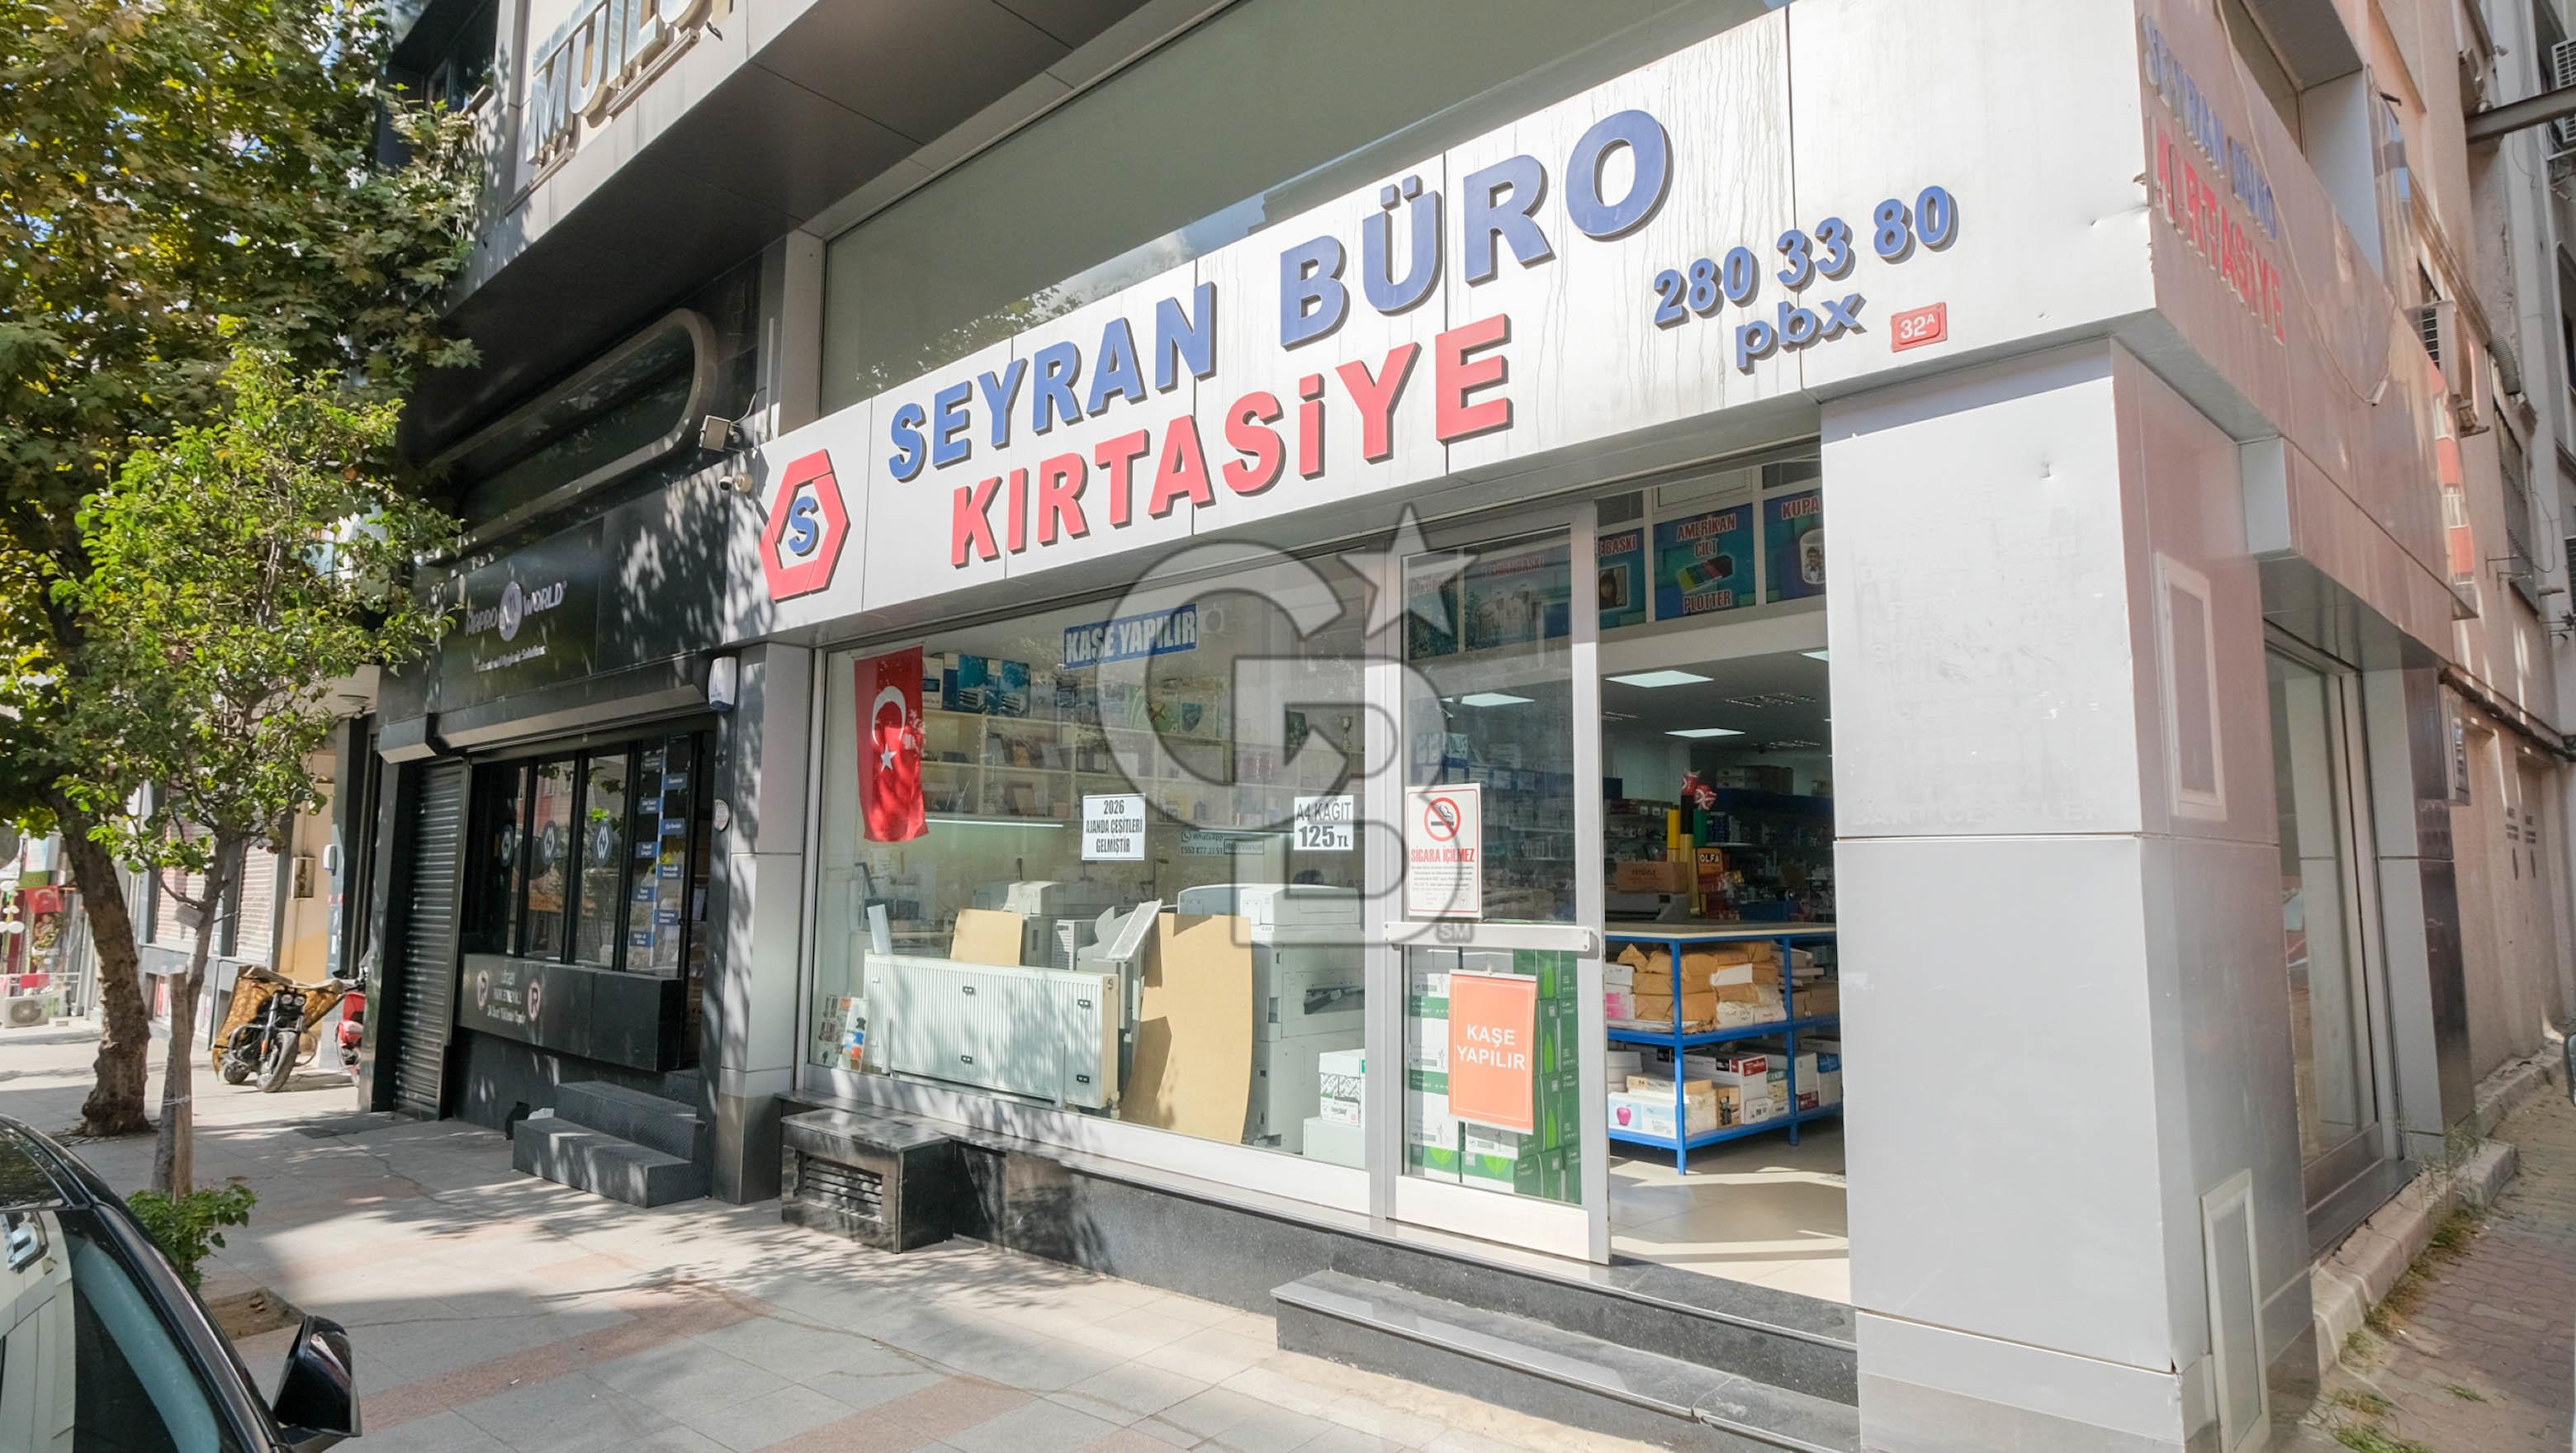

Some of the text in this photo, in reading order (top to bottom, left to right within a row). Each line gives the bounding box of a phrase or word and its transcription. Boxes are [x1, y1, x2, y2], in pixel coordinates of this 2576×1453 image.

[1653, 185, 1959, 331] 280 33 80
[888, 109, 1674, 483] SEYRAN BÜRO
[1735, 292, 1868, 376] pbx
[1780, 495, 1821, 520] KUPA
[788, 495, 819, 556] S
[1676, 514, 1737, 542] AMERİKAN
[523, 582, 564, 617] WORLD
[1683, 589, 1732, 614] PLOTTER
[1118, 610, 1196, 655] YAPILIR
[1103, 799, 1125, 815] 2026
[1296, 798, 1352, 821] A4 KAĞIT
[1298, 826, 1349, 848] 125 TL
[1411, 845, 1441, 863] SİGARA
[1699, 854, 1721, 864] OLFA
[1466, 1024, 1516, 1047] KAŞE
[1456, 1044, 1526, 1071] YAPILIR
